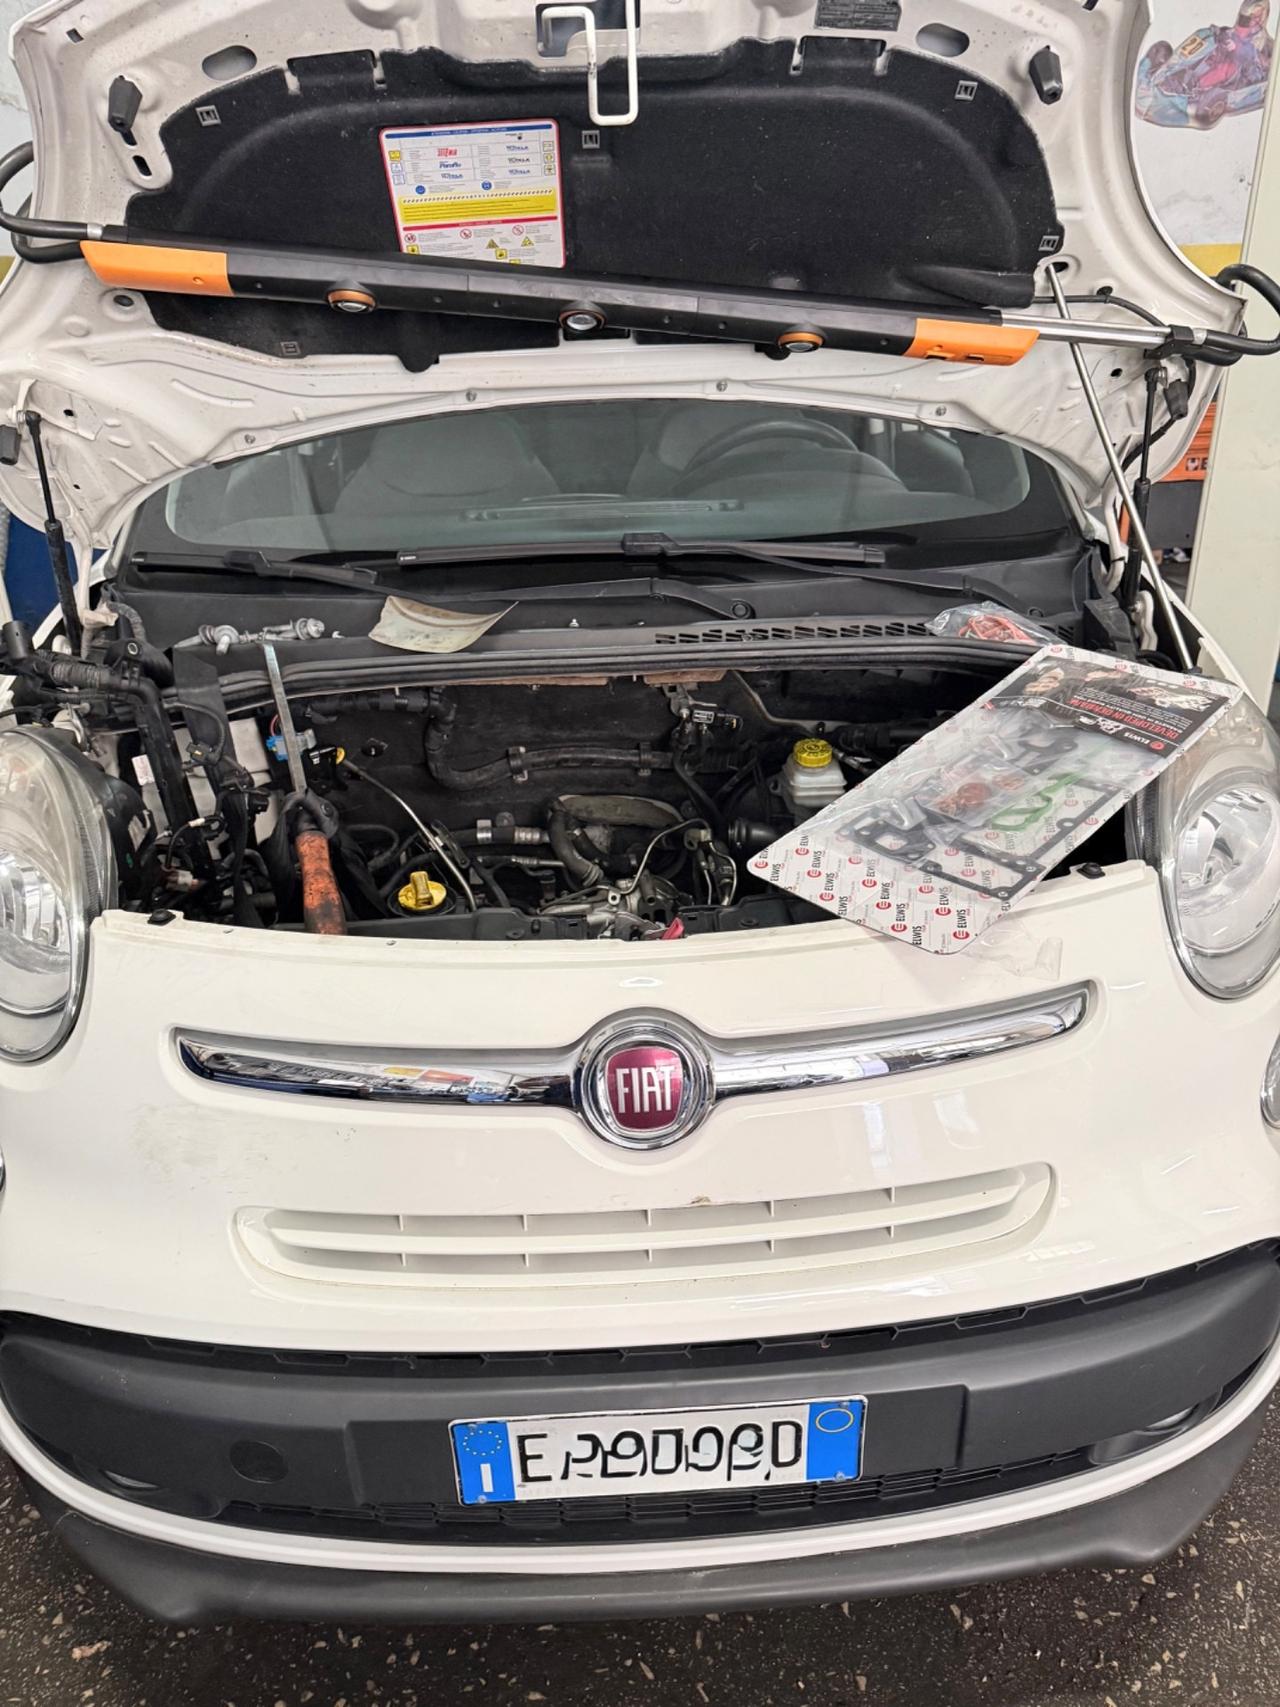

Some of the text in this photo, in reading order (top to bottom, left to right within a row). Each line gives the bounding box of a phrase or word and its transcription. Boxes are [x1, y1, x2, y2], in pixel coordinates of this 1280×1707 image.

[1123, 713, 1179, 740] DEVELOPED
[1123, 732, 1150, 745] ELWIS
[811, 850, 822, 869] ELWIS
[770, 863, 781, 882] ELWIS
[824, 872, 835, 891] ELWIS
[880, 882, 891, 900] ELWIS
[939, 886, 949, 905] ELWIS
[838, 895, 848, 916] ELWIS
[895, 903, 906, 922] ELWIS
[957, 909, 967, 928] ELWIS
[912, 925, 922, 945] ELWIS
[615, 1065, 675, 1114] FIAT
